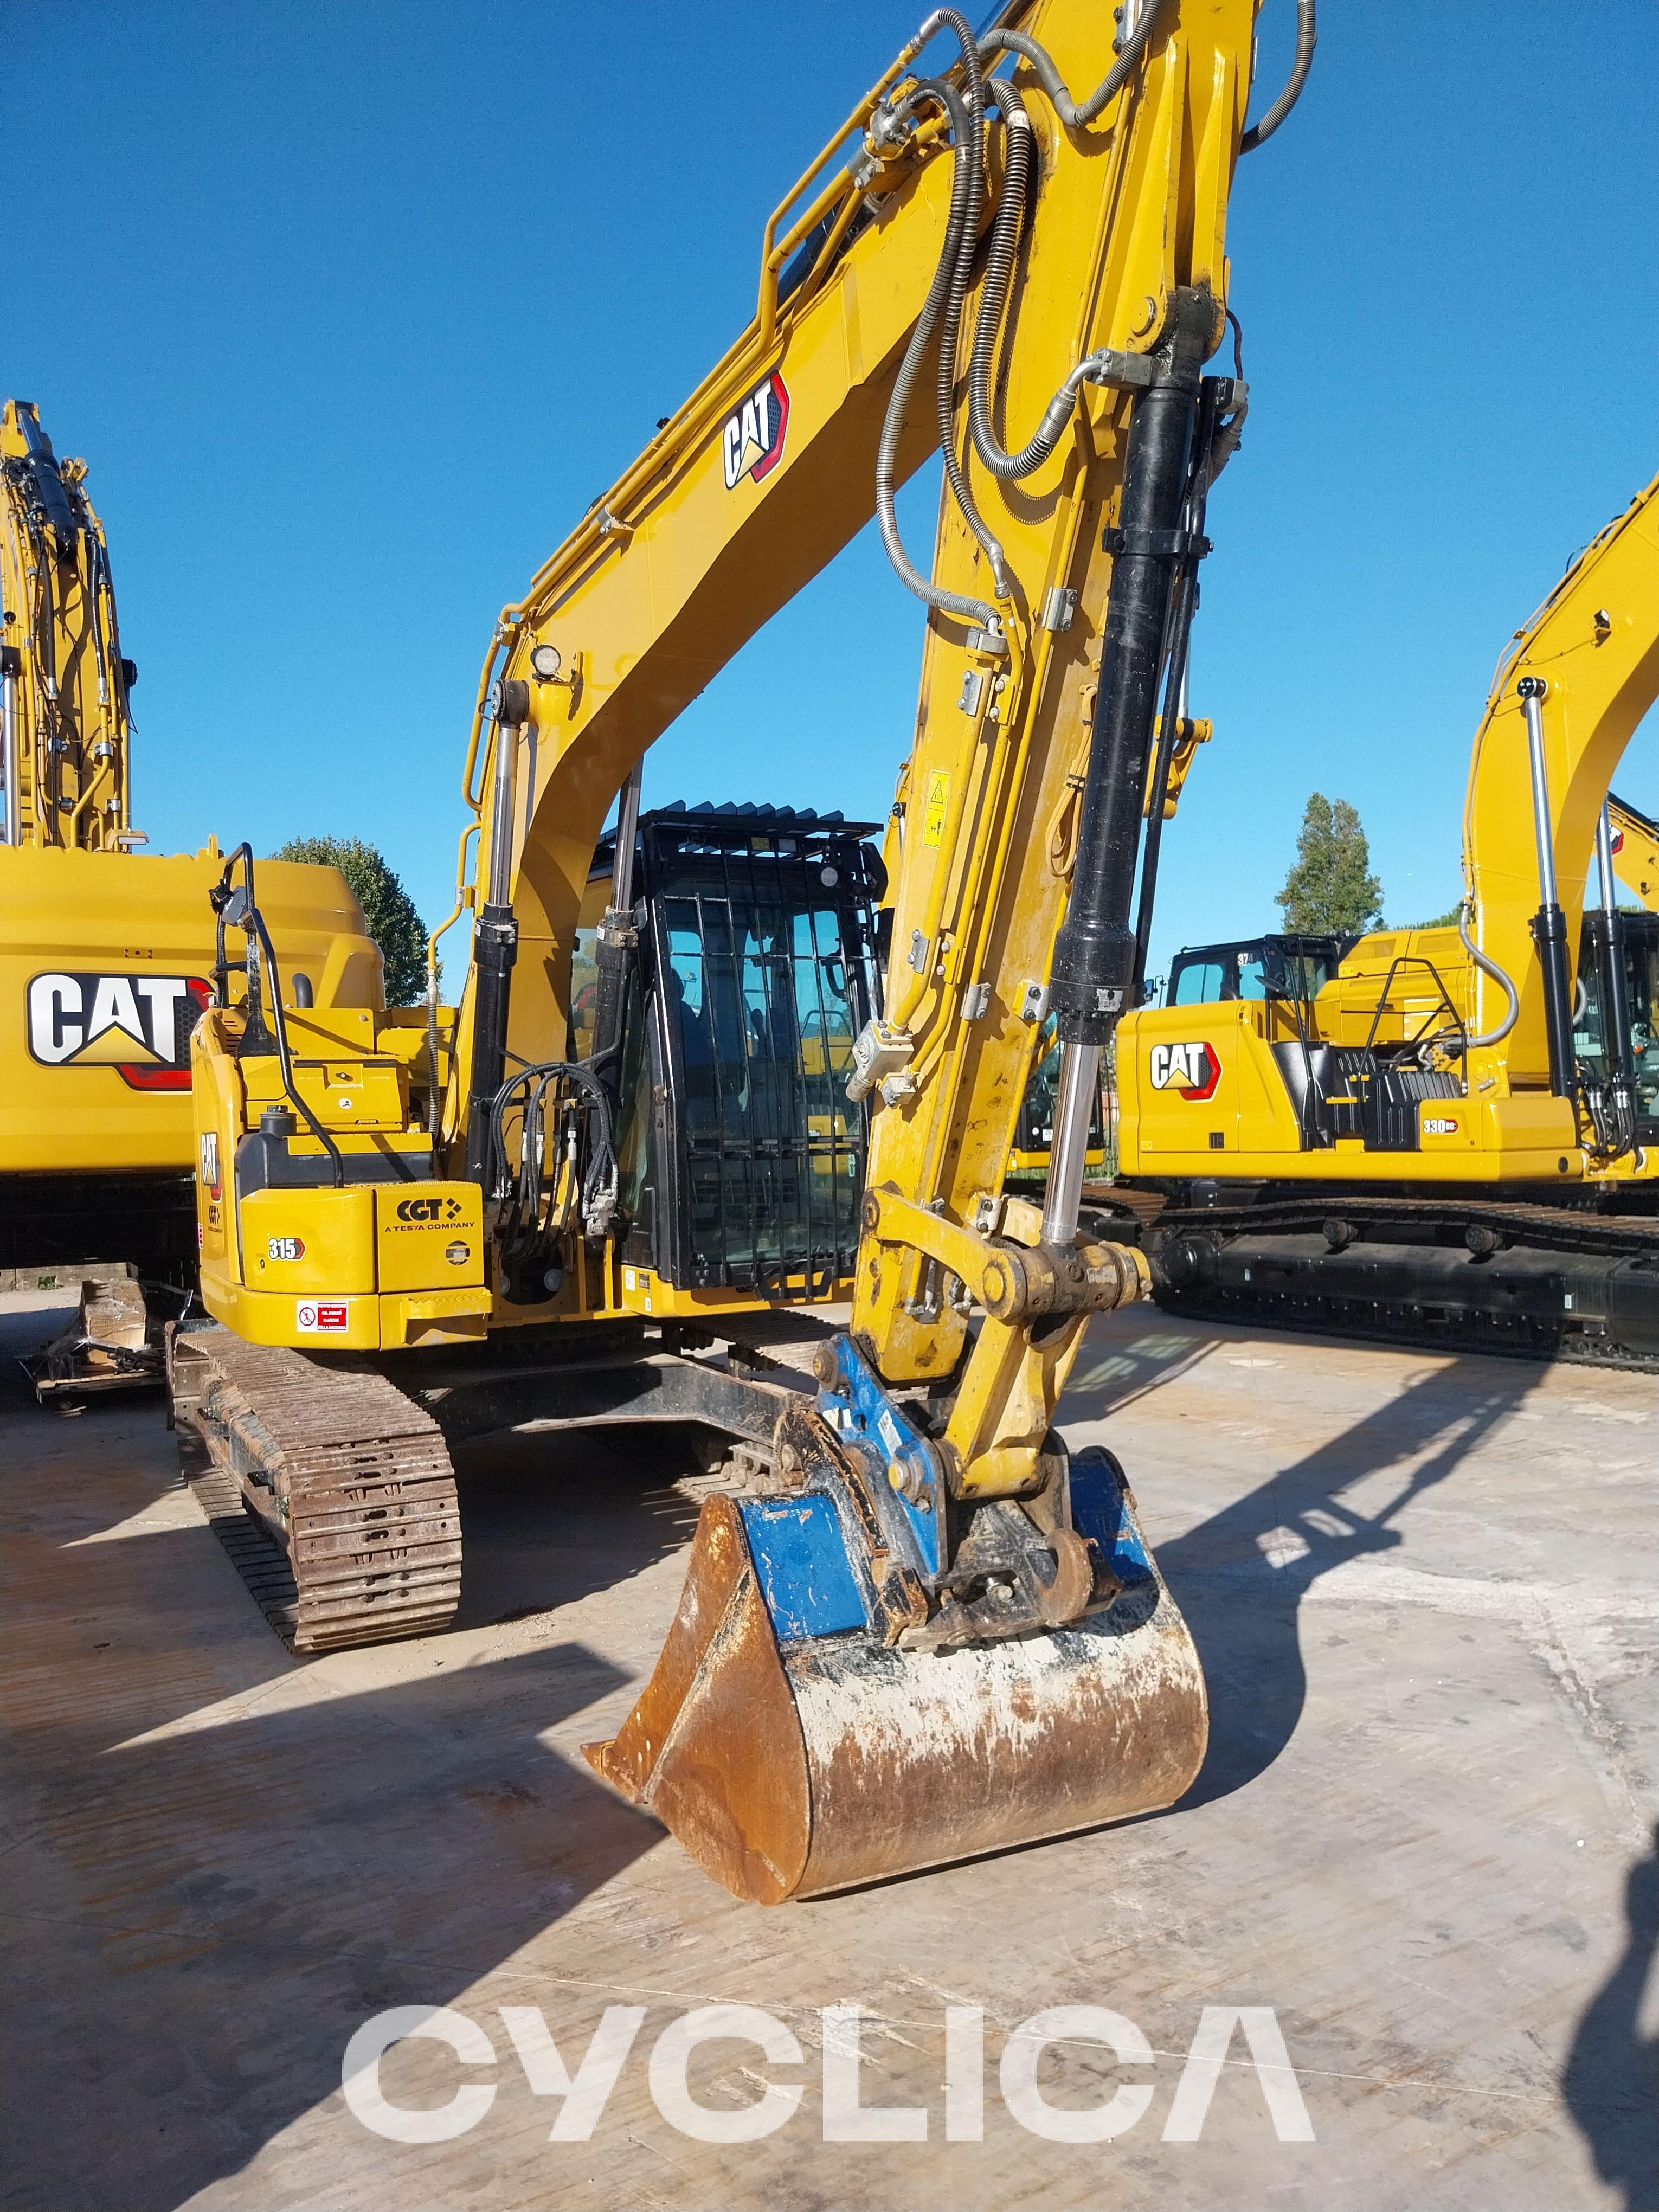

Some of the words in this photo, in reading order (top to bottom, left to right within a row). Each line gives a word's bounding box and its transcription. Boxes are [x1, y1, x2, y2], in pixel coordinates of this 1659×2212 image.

[724, 380, 771, 487] CAT
[31, 974, 187, 1063] CAT
[1151, 1043, 1203, 1089] CAT
[1423, 1120, 1445, 1133] 330
[201, 1134, 217, 1184] CAT
[397, 1199, 443, 1222] CGT
[427, 1221, 475, 1230] COMPANY
[269, 1238, 295, 1259] 315
